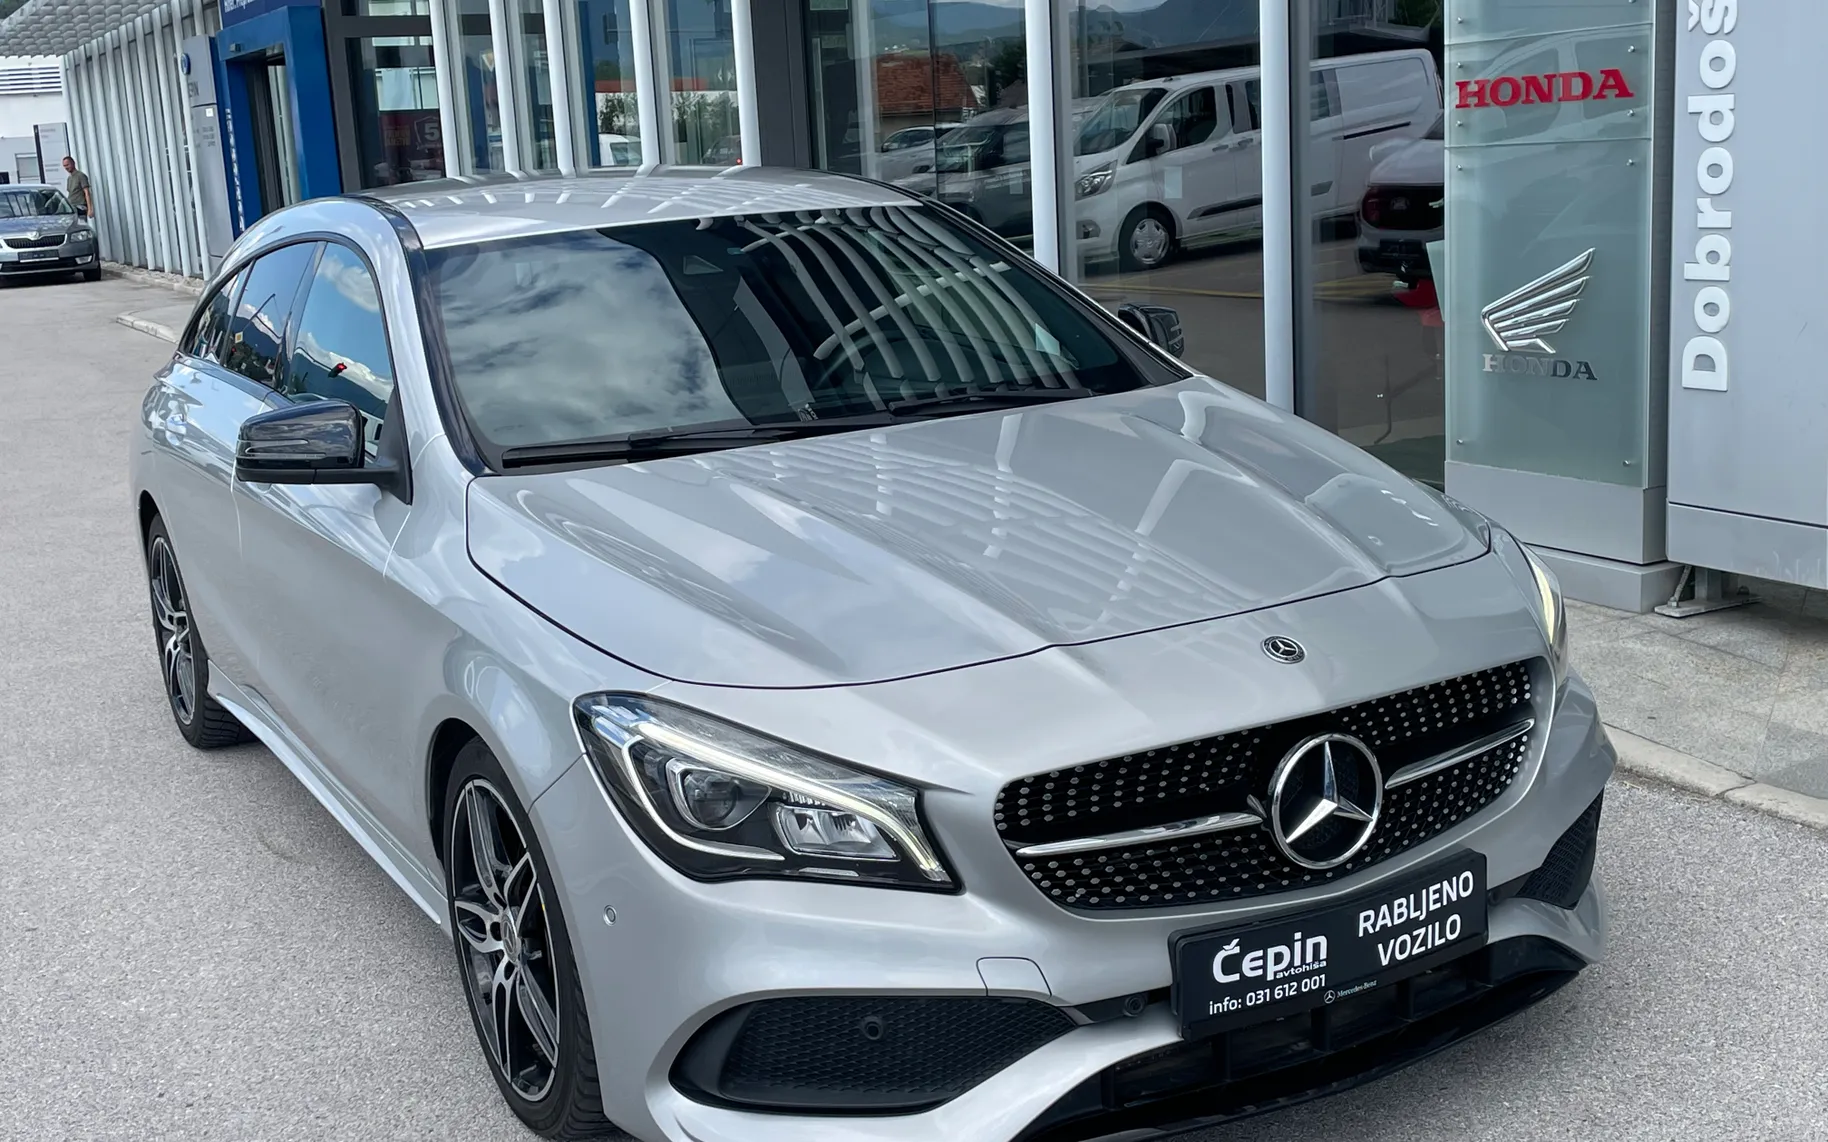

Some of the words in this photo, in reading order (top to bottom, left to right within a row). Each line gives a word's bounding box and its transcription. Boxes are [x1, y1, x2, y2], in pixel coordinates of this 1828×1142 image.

[1455, 68, 1634, 109] HONDA
[1482, 353, 1598, 381] HONDA
[1357, 870, 1475, 938] RABLJENO
[1377, 914, 1462, 967] VOZILO
[1275, 960, 1327, 979] avtohiša
[1209, 997, 1242, 1015] info:
[1246, 988, 1271, 1007] 031
[1274, 981, 1298, 1000] 612
[1301, 973, 1327, 993] 001
